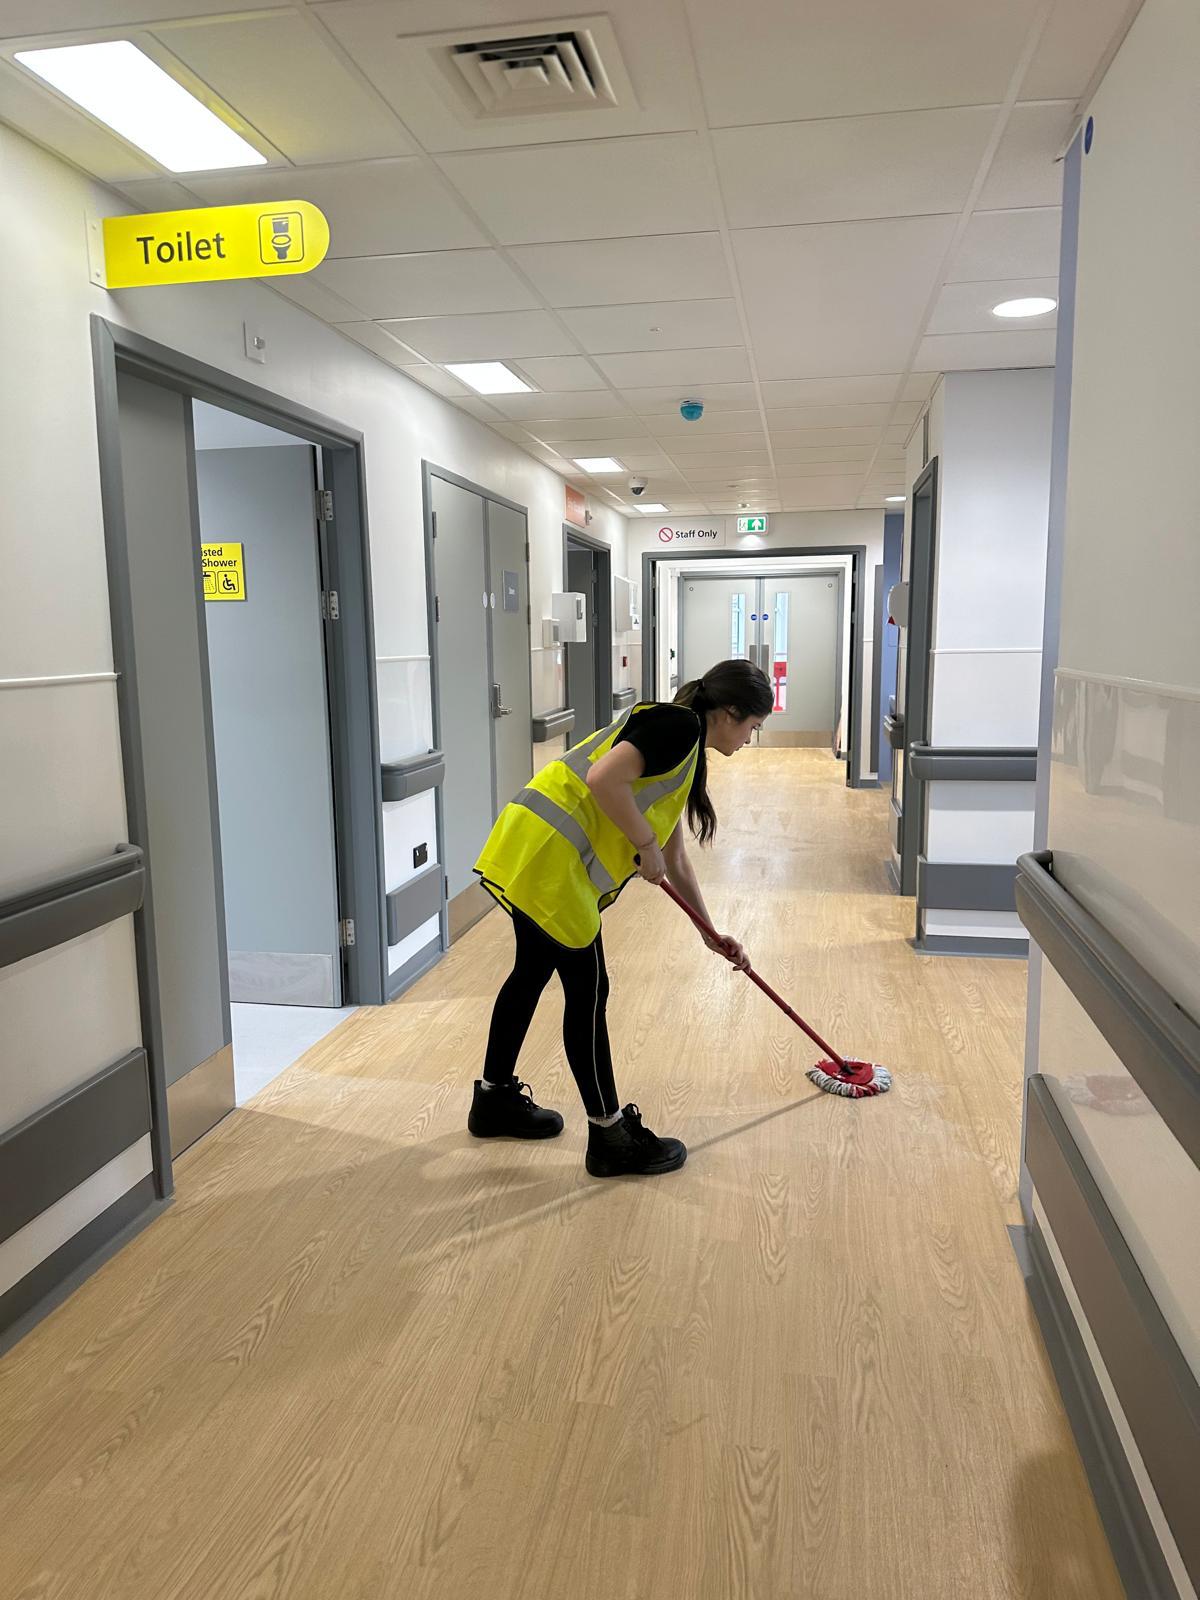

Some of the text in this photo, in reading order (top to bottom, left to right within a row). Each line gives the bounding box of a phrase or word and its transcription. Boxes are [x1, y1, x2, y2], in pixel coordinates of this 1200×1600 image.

[136, 231, 225, 264] Toilet
[675, 530, 717, 539] Staff Only
[202, 558, 237, 567] Shower
